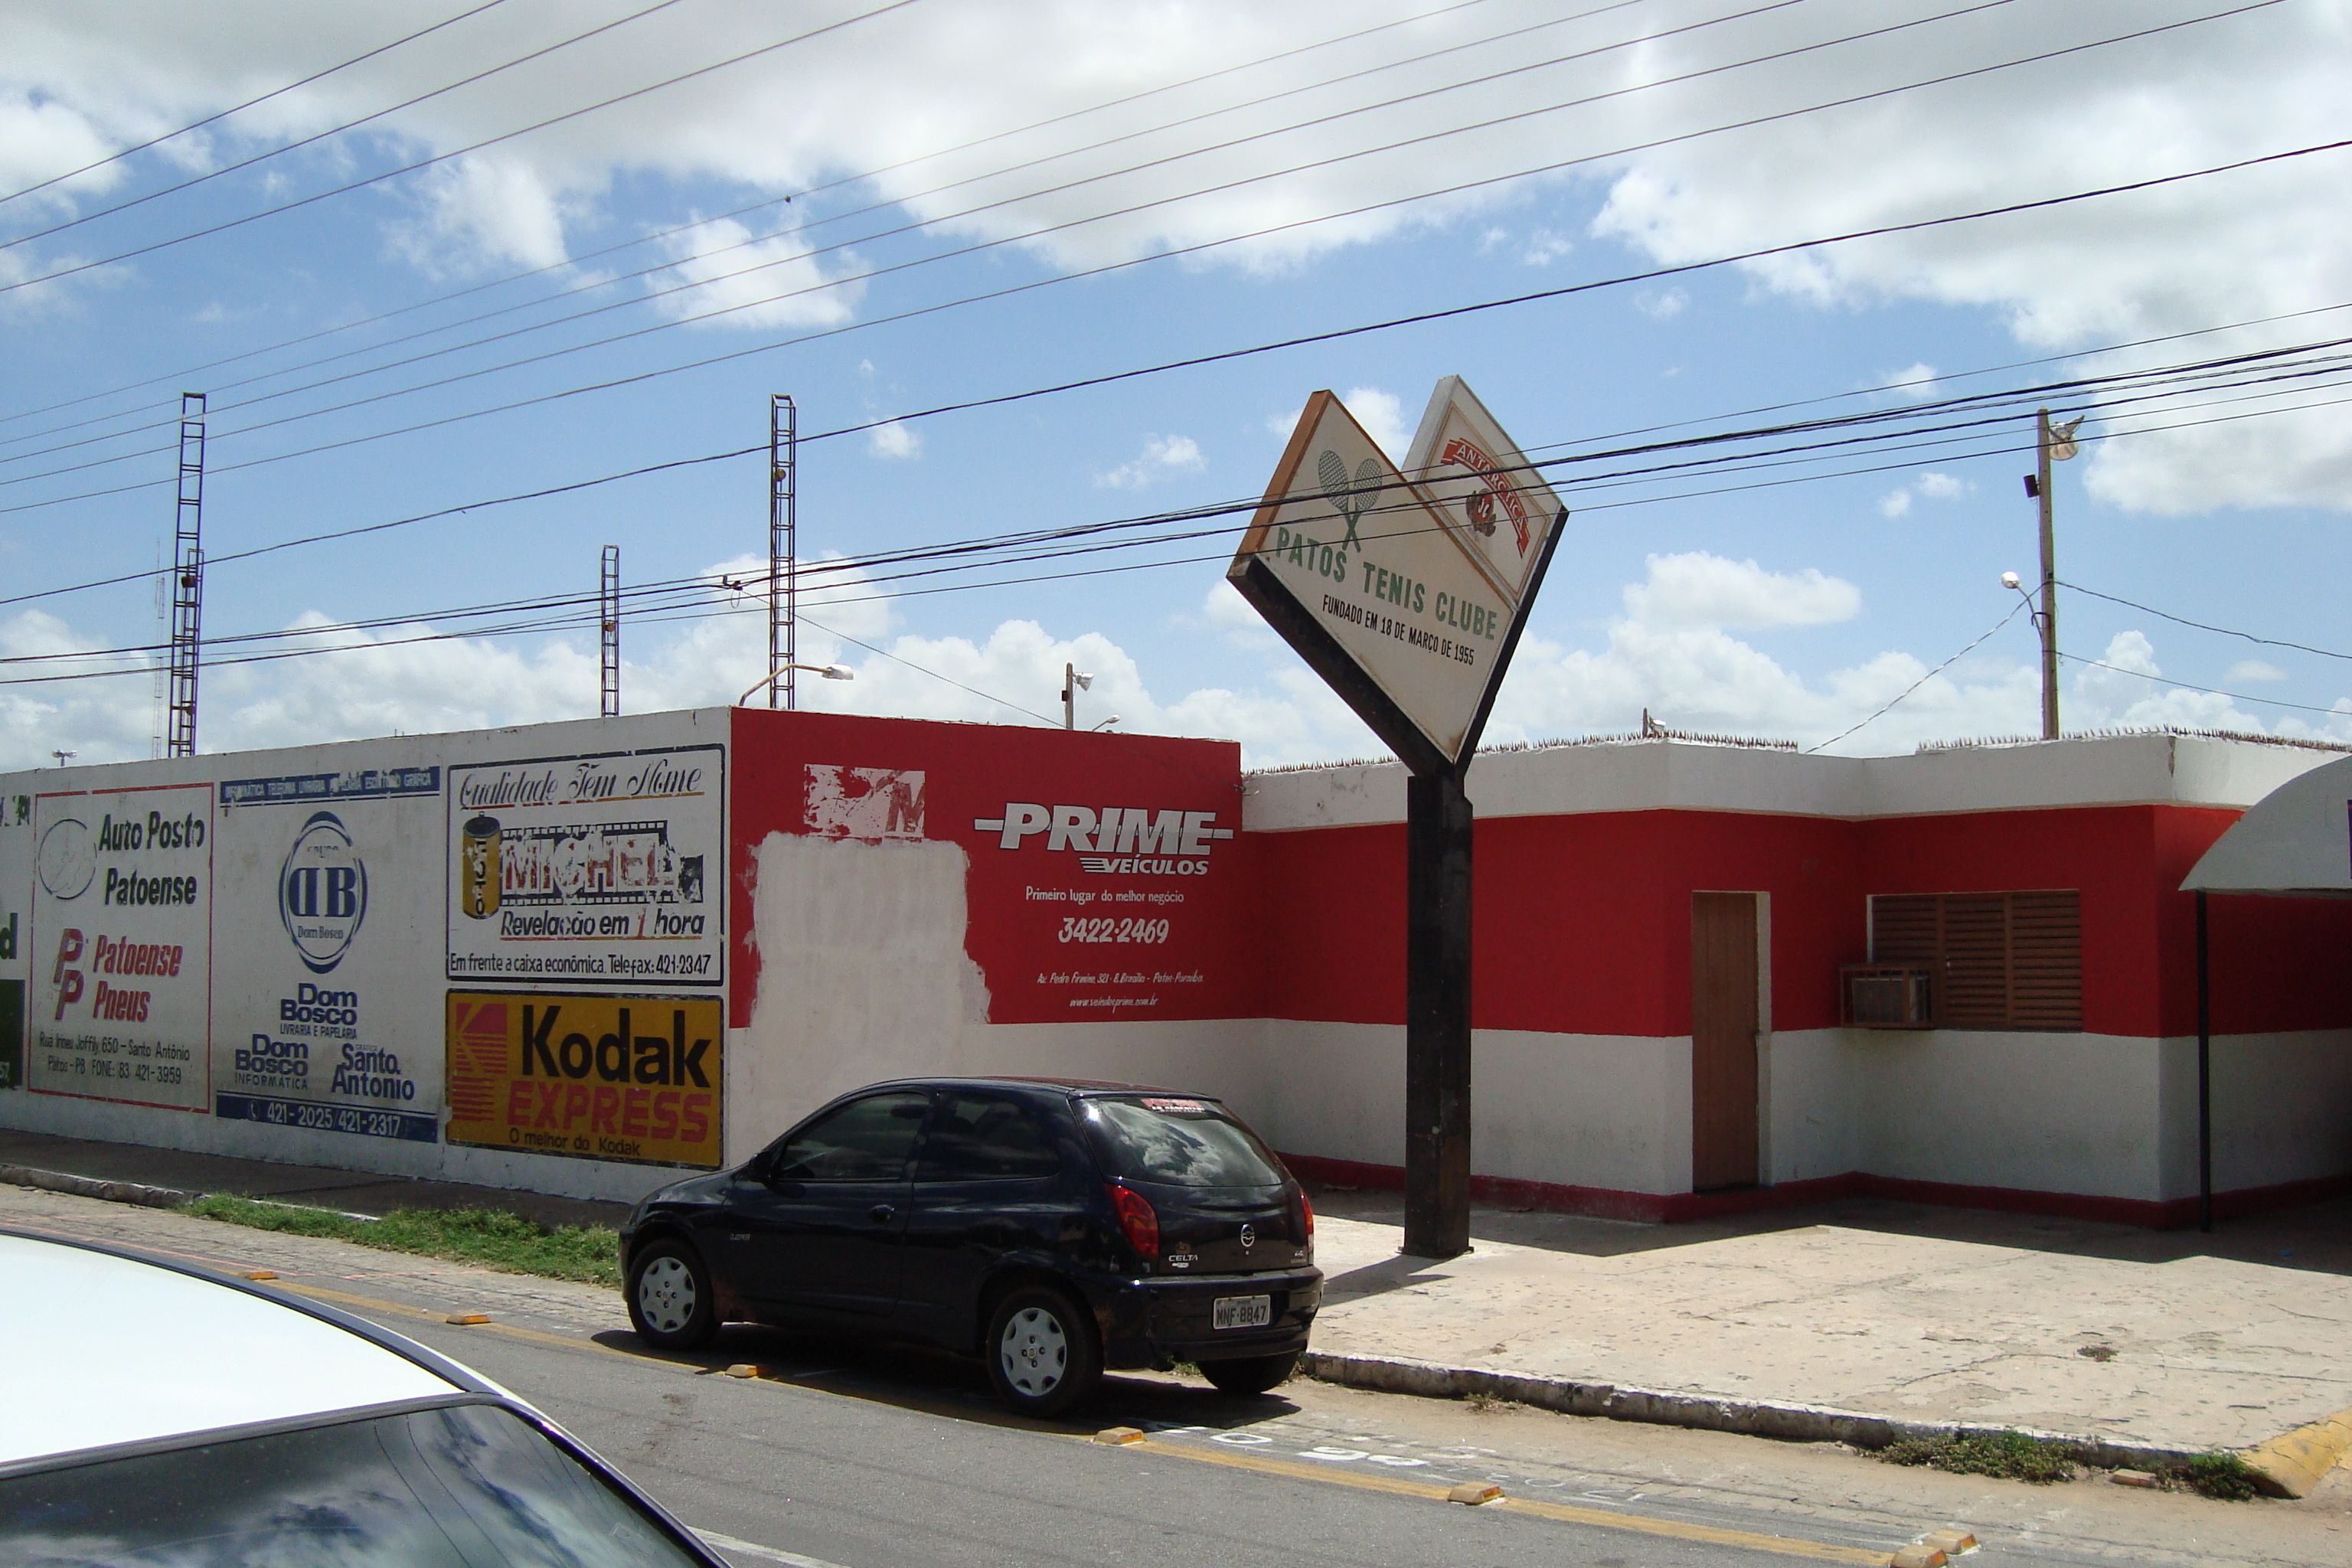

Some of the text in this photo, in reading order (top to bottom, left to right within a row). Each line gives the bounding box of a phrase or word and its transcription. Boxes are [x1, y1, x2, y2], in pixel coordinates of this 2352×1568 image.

[1276, 526, 1497, 641] PATOS TENIS CLUBE
[1322, 594, 1475, 665] FUNDADO EM 18 DE MARÇO DE 1955
[460, 759, 703, 810] Qualidade Tem Nome
[99, 811, 205, 851] Auto Posto
[999, 802, 1217, 856] PRIME
[1099, 854, 1209, 875] VEÍCULOS
[105, 867, 197, 906] Patoense
[1026, 886, 1184, 905] Primeiro lugar do melhor negócio
[501, 908, 704, 939] Revelação em 1 hora
[93, 934, 183, 978] Patoense
[450, 953, 466, 972] Em
[469, 952, 502, 972] frente
[505, 958, 511, 972] a
[514, 956, 543, 972] caixa
[93, 980, 151, 1022] Pneus
[298, 983, 358, 1007] Dom
[280, 998, 358, 1025] Bosco
[40, 1031, 53, 1048] Rua
[102, 1037, 119, 1054] 650
[129, 1039, 151, 1057] Santo
[155, 1040, 191, 1062] Antônio
[252, 1034, 309, 1059] Dom
[280, 1024, 358, 1040] LIVRARIA E PAPELARIA
[522, 1004, 712, 1088] Kodak
[76, 1057, 86, 1075] PB
[92, 1059, 115, 1078] FONE:
[119, 1062, 129, 1080] 83
[136, 1064, 181, 1085] 421-3959
[235, 1049, 309, 1076] Bosco
[342, 1043, 399, 1073] Santo
[507, 1080, 712, 1144] EXPRESS
[509, 1128, 642, 1157] O melhor do Kodak
